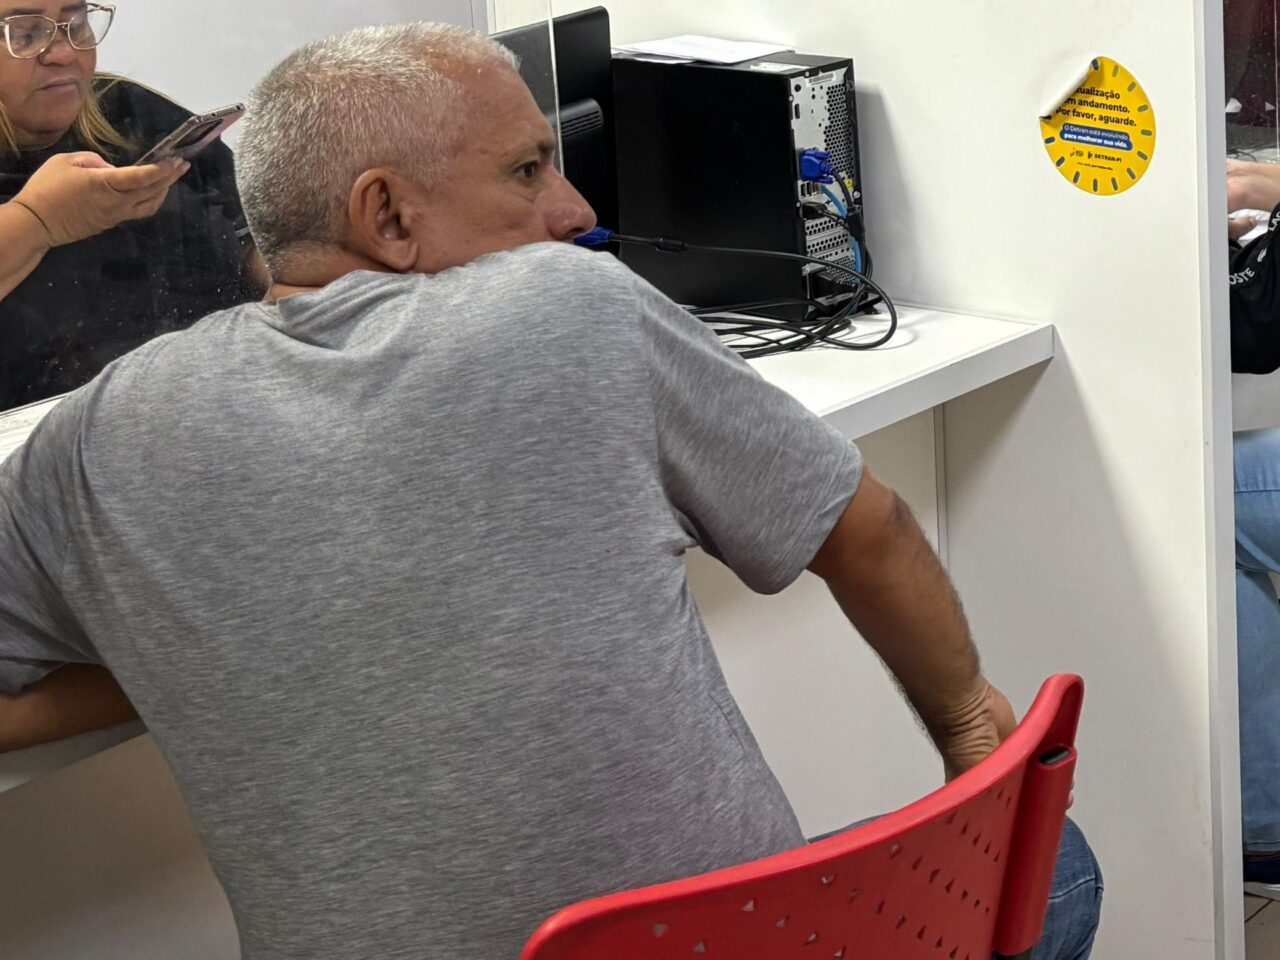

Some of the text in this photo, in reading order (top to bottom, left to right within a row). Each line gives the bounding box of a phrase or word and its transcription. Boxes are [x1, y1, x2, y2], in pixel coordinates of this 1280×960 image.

[1077, 87, 1121, 100] ualização
[1078, 99, 1130, 113] andamento.
[1072, 108, 1097, 122] favor,
[1099, 115, 1136, 126] aguarde.
[1070, 125, 1089, 134] Detran
[1229, 267, 1255, 285] OSTE
